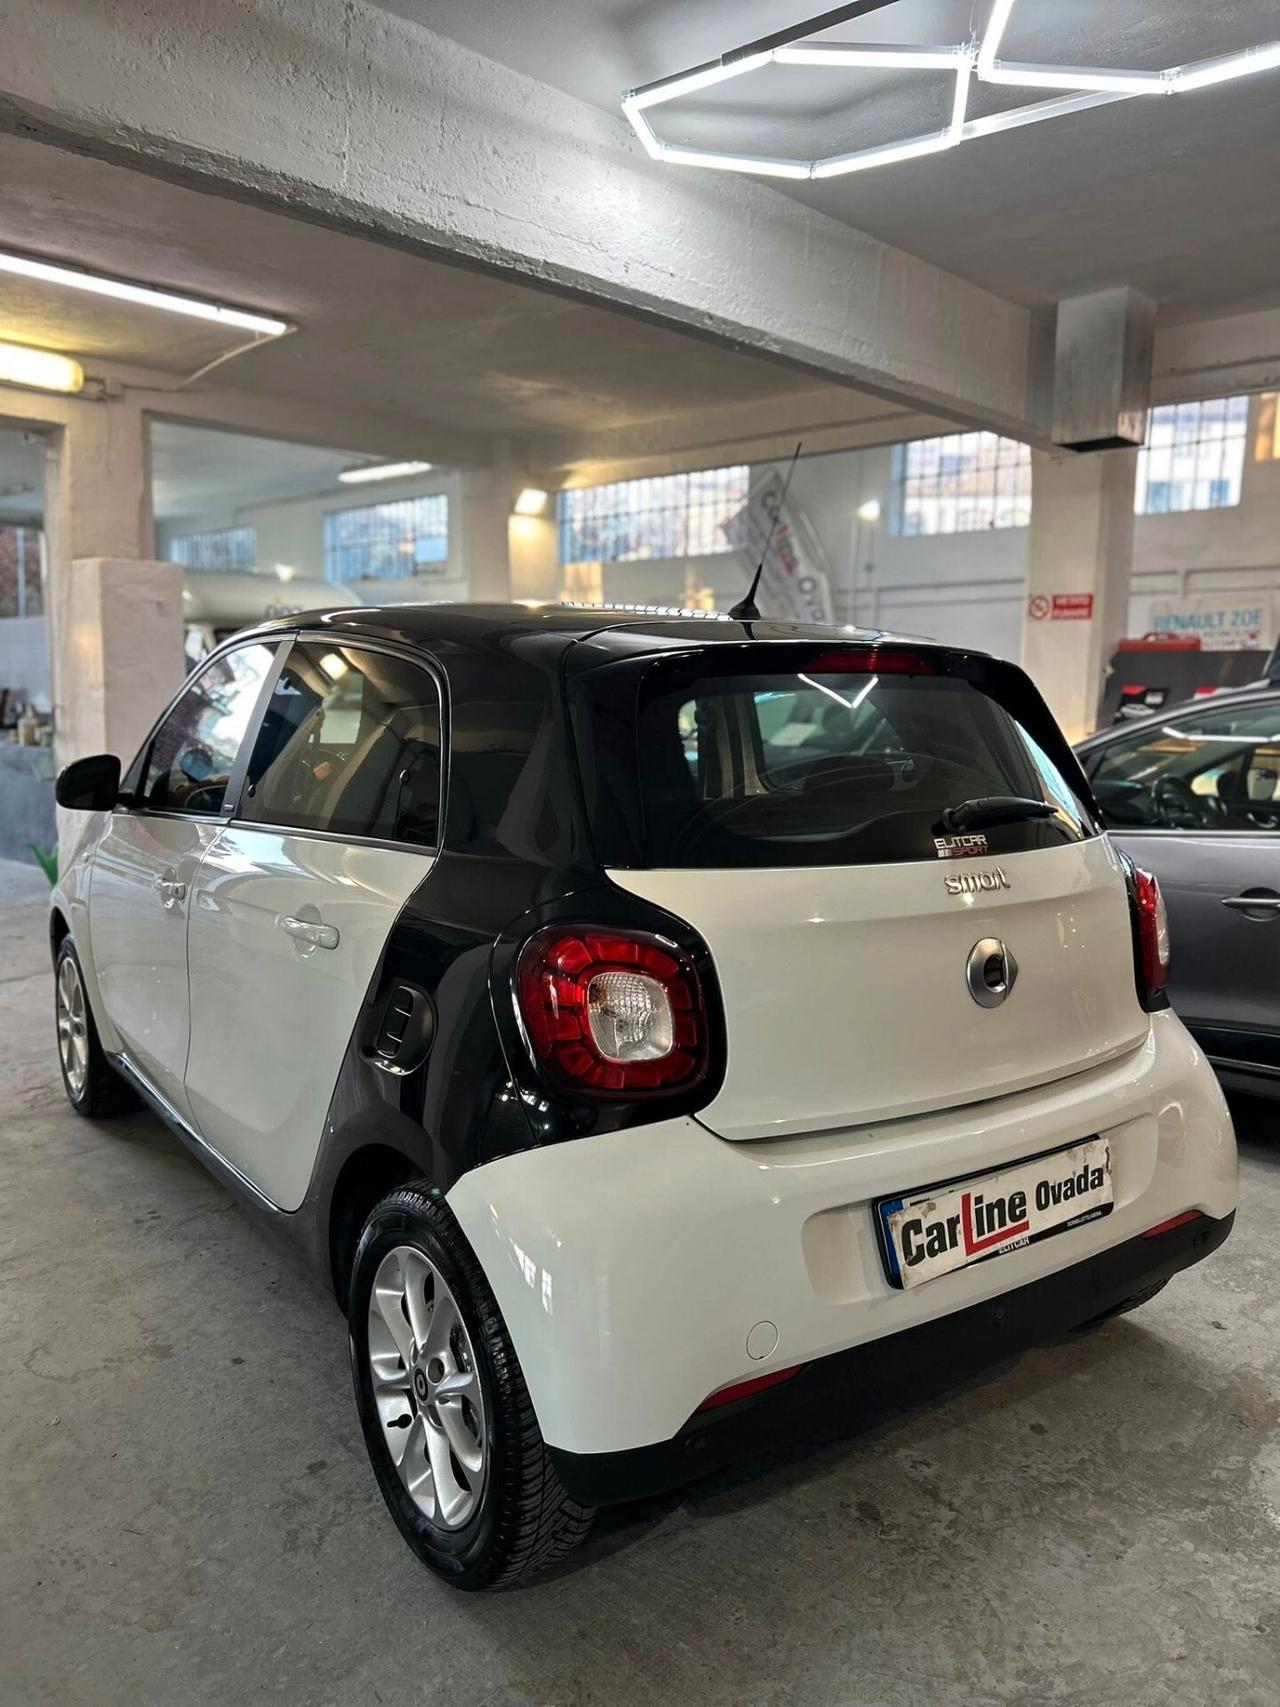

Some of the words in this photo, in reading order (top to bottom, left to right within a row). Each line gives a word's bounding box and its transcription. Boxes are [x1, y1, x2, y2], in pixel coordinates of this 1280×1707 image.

[1152, 611, 1226, 630] RENAULT
[1231, 608, 1263, 627] ZOE
[933, 834, 987, 849] ELITCAR
[951, 846, 988, 857] SPORT
[944, 866, 1011, 895] smart
[901, 1192, 1030, 1267] CarLine
[1035, 1164, 1104, 1212] Ovada
